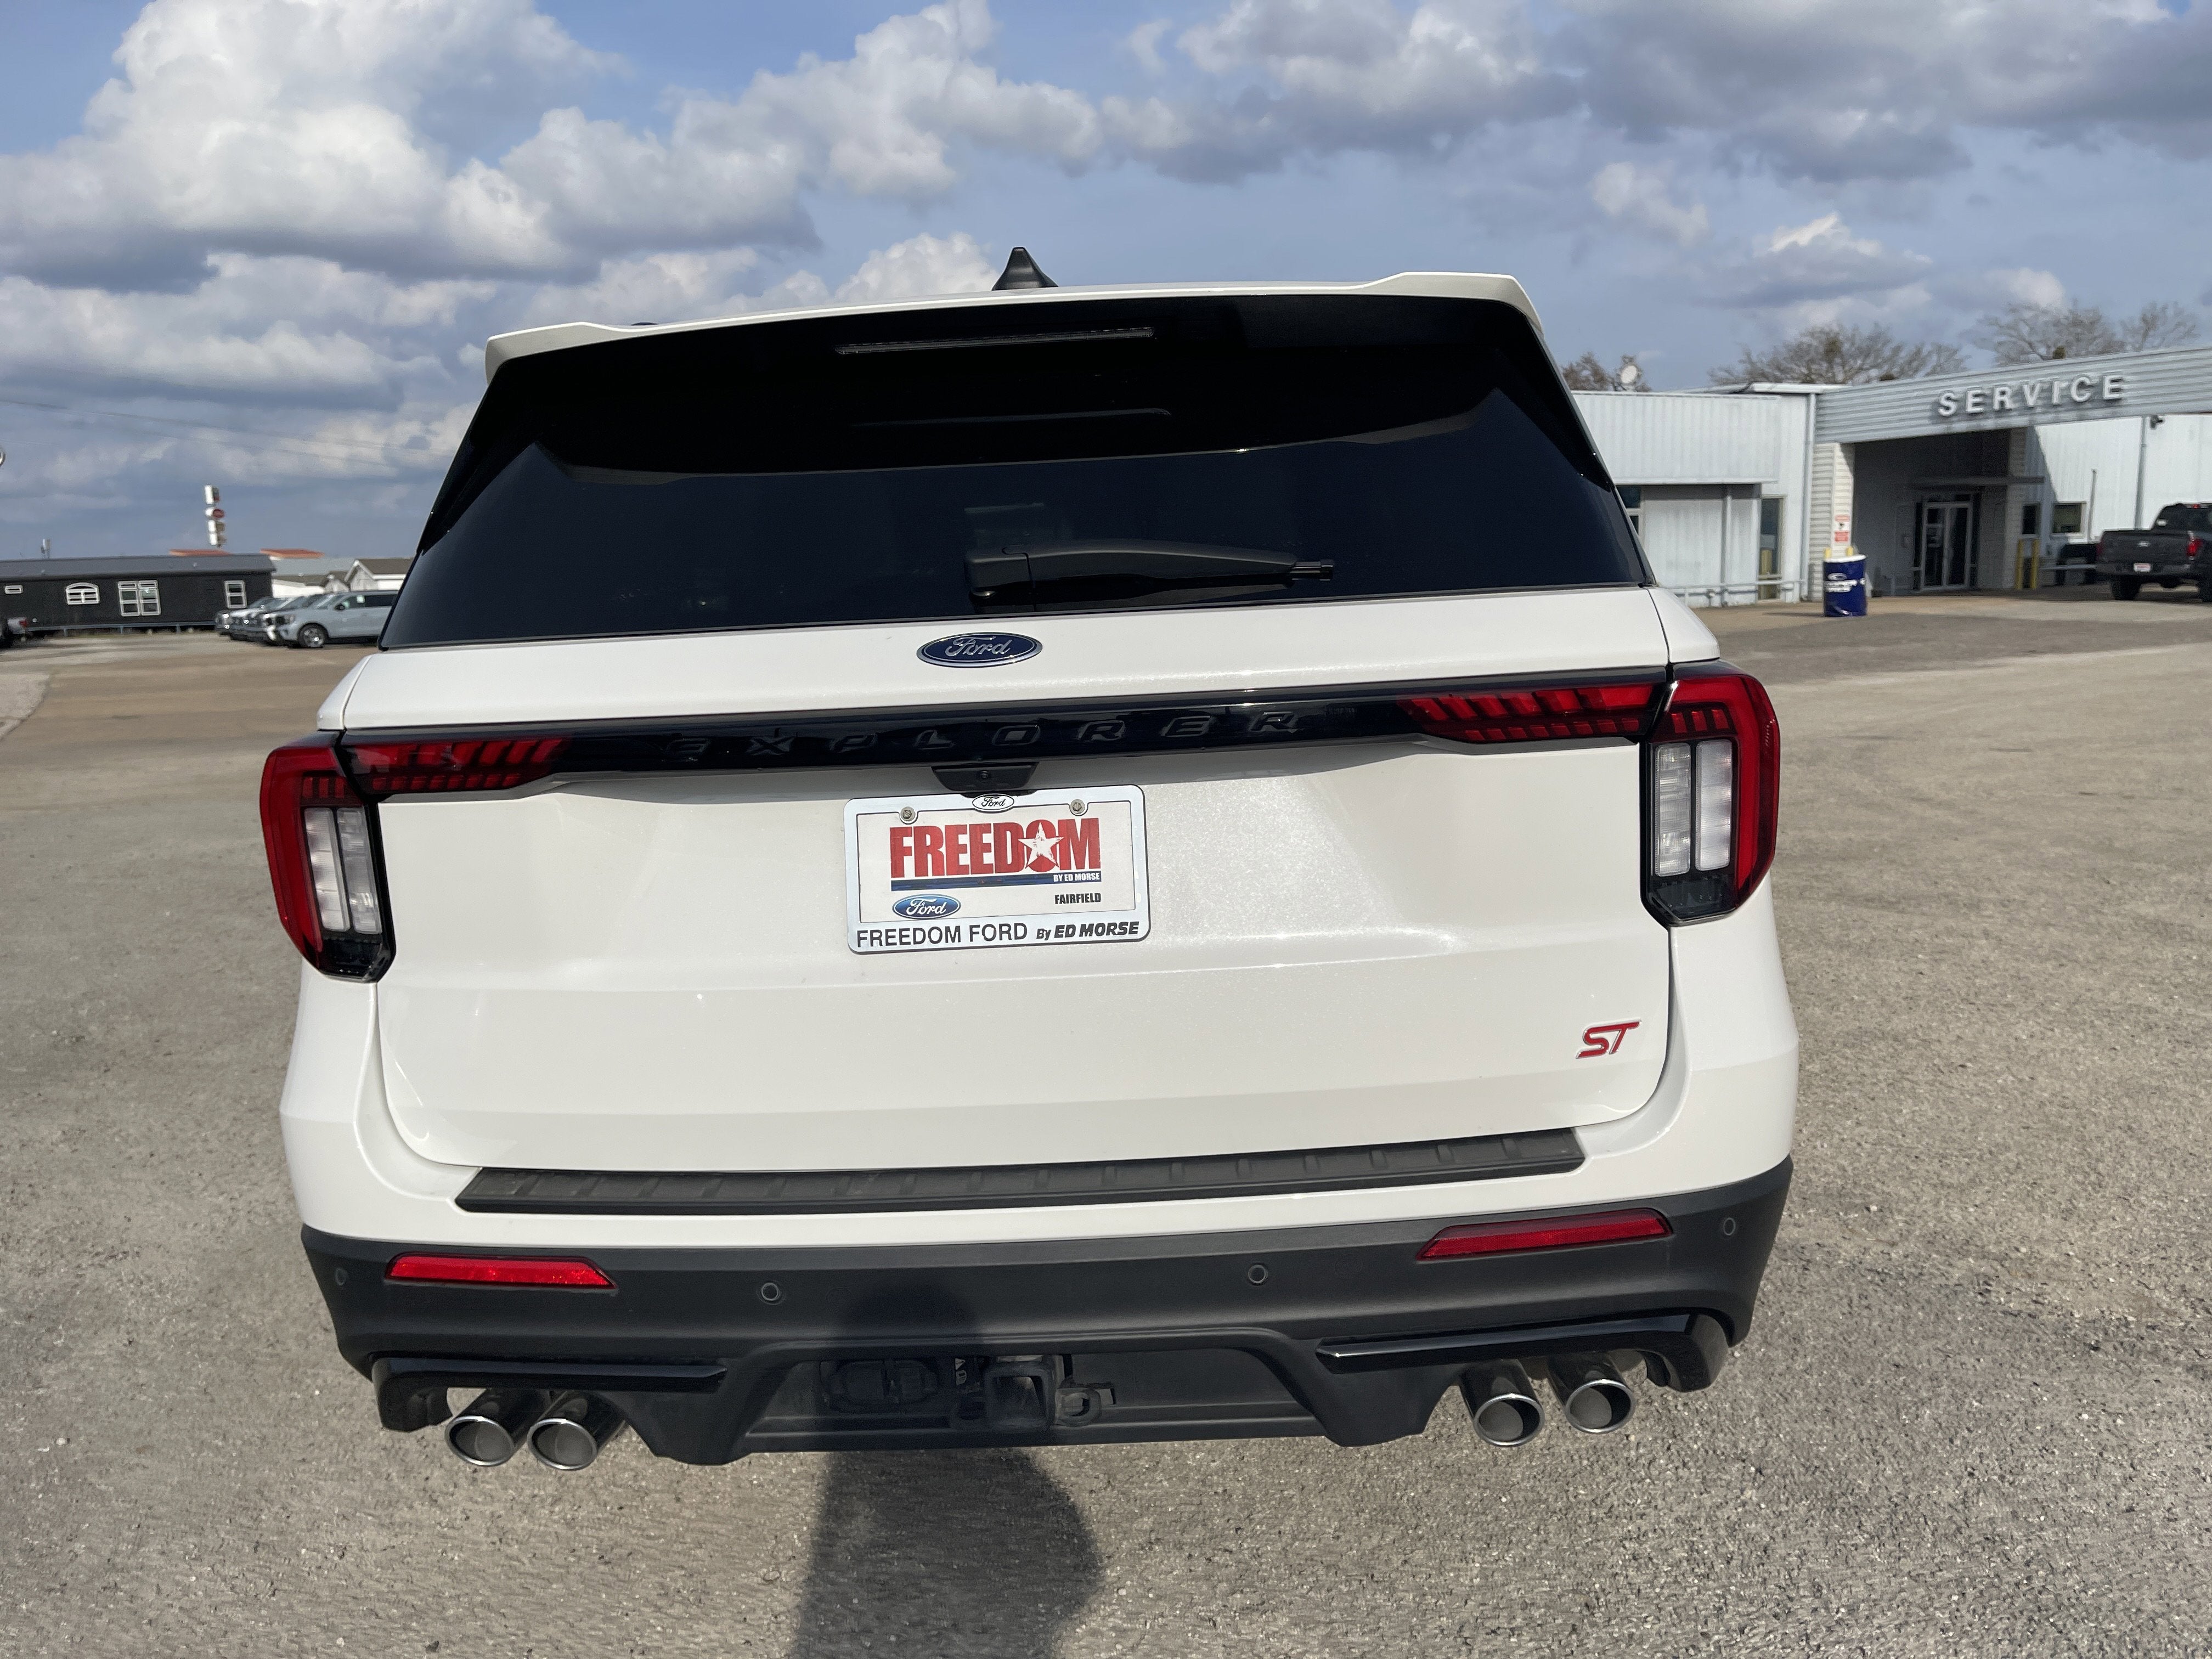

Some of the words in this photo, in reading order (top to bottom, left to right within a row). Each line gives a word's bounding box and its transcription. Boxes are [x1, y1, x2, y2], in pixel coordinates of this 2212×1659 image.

[1938, 375, 2124, 417] SERVICE
[945, 636, 1013, 657] Ford
[662, 710, 1304, 757] EXPLORER
[981, 796, 1006, 807] Ford
[889, 817, 1101, 878] FREEDOM
[1053, 874, 1063, 882] BY
[1064, 873, 1074, 882] ED
[1075, 872, 1100, 881] MORSE
[906, 898, 947, 915] Ford
[1054, 893, 1102, 905] FAIRFIELD
[856, 925, 961, 948] FREEDOM
[969, 922, 1028, 943] FORD
[1036, 928, 1052, 941] By
[1054, 924, 1076, 939] ED
[1079, 921, 1139, 938] MORSE
[1575, 1018, 1642, 1059] ST
